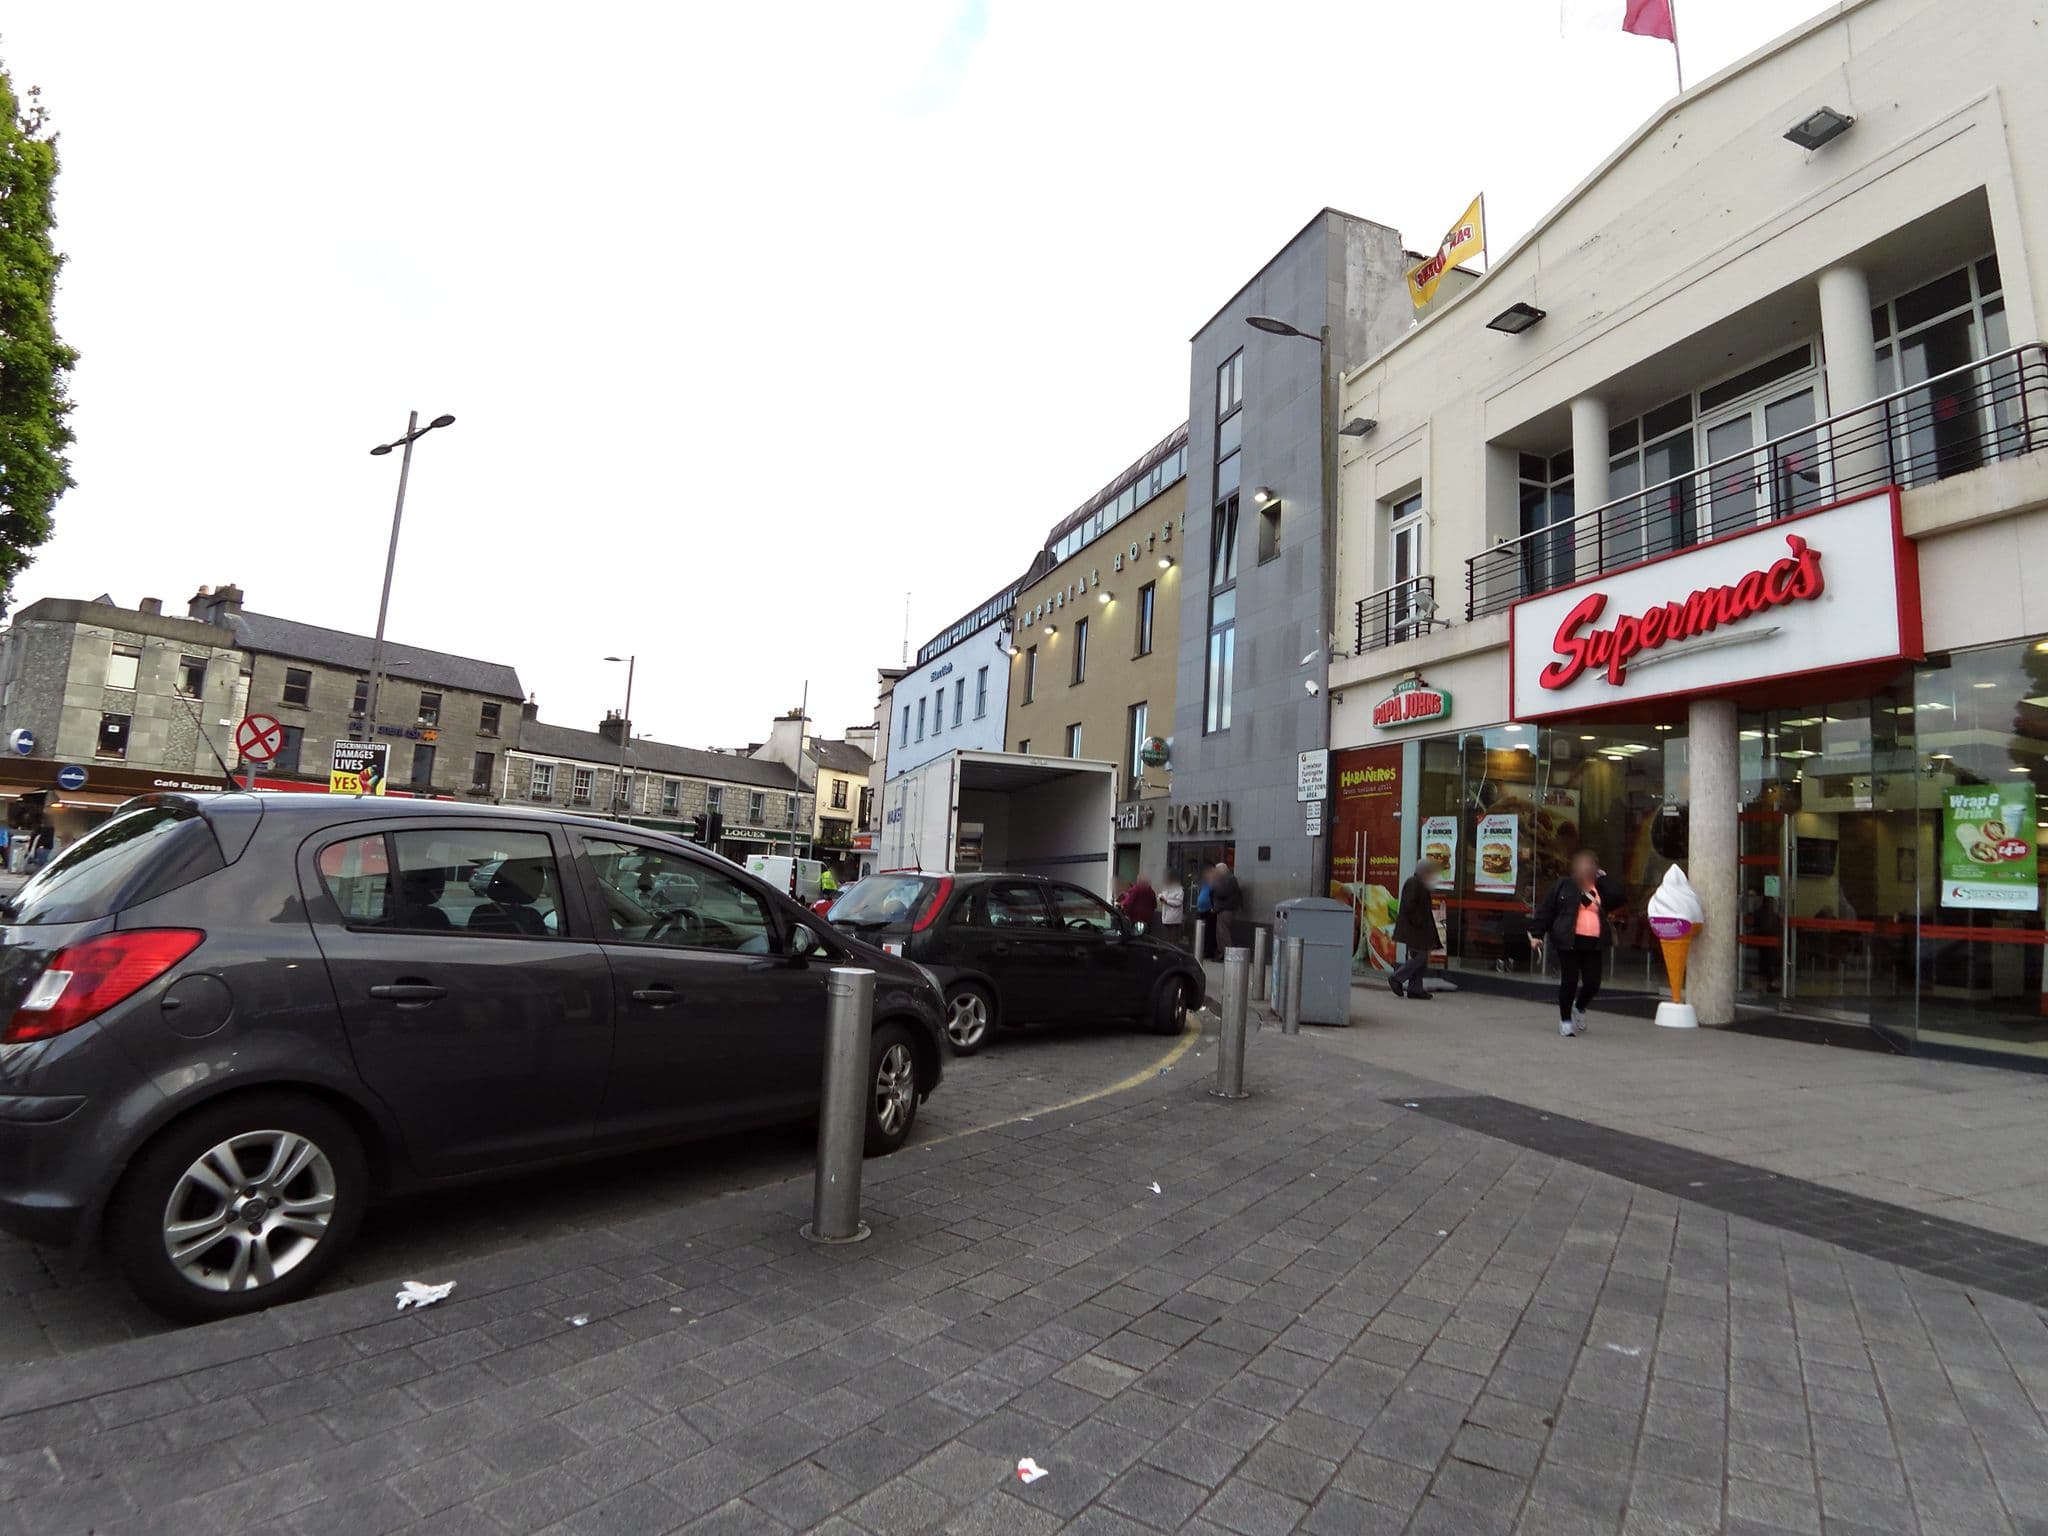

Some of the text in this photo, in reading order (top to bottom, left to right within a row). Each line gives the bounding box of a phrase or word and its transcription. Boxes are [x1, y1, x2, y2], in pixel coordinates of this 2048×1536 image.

[1016, 568, 1099, 632] IMPERIAL
[1539, 533, 1826, 691] Supermac's
[1374, 696, 1402, 725] PAPA
[336, 742, 386, 751] DISCRIMINATION
[335, 749, 374, 760] DAMAGES
[334, 759, 364, 771] LIVES
[181, 781, 223, 792] Express
[333, 776, 358, 790] YES
[1950, 794, 1987, 810] Wrap
[1167, 799, 1233, 834] HOTEL
[1953, 806, 1994, 820] Drink
[724, 828, 767, 839] LOGUES
